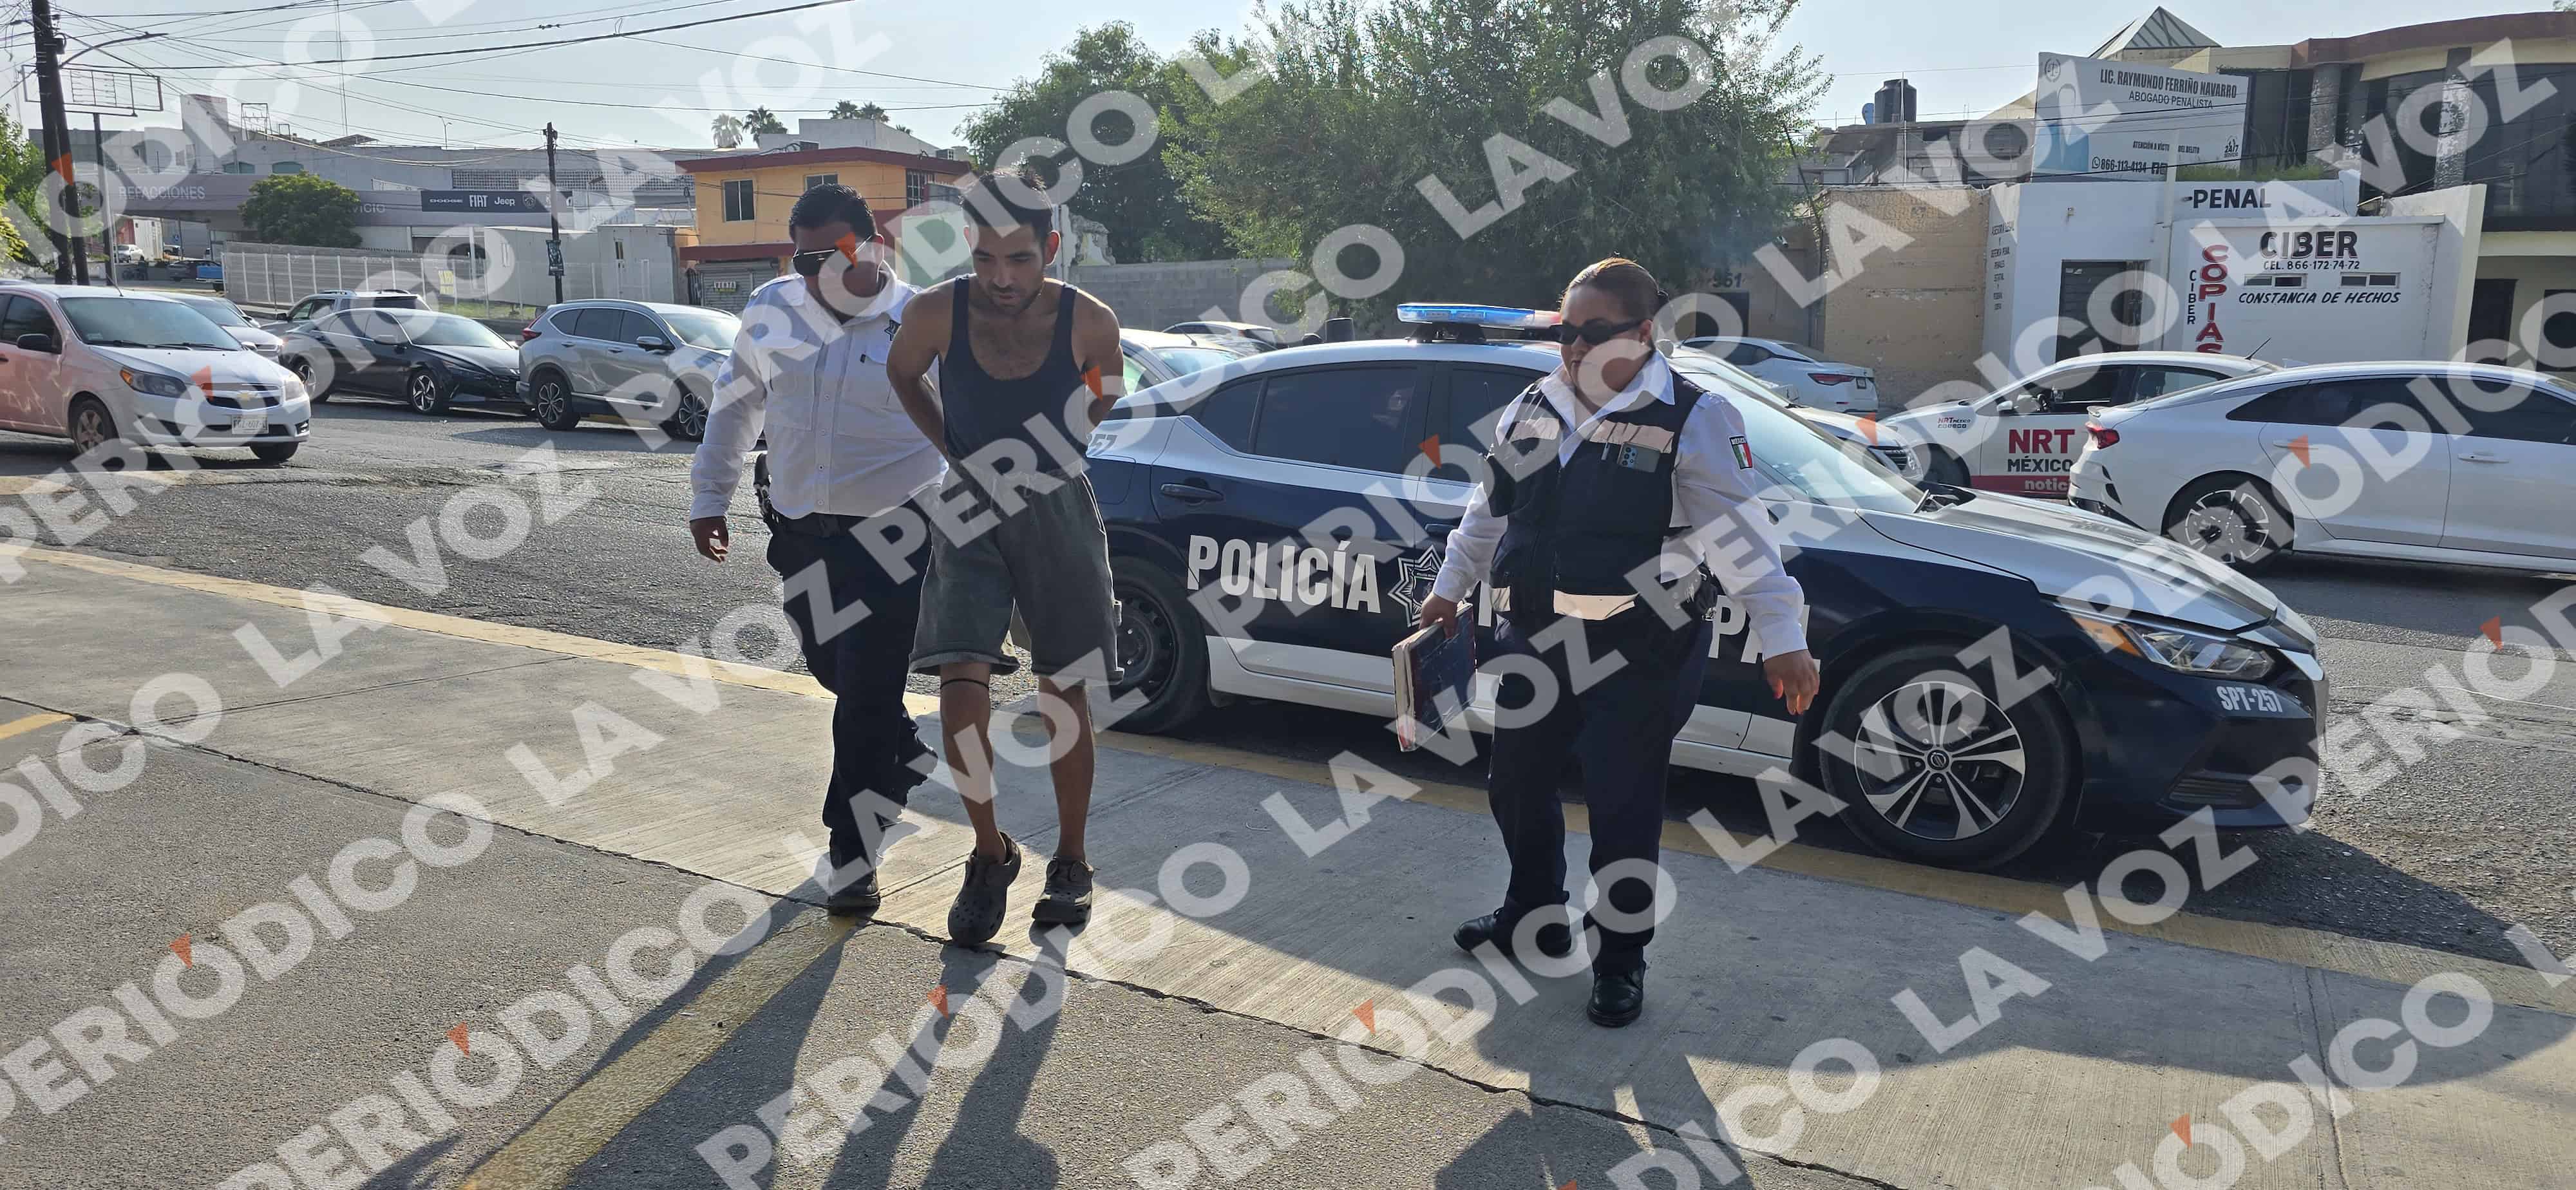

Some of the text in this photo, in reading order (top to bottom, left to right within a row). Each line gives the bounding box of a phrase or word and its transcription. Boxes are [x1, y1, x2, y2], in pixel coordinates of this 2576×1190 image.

[2100, 68, 2237, 99] LIC. RAYMUNDO FERRIÑO NAVARRO
[2128, 90, 2213, 109] ABOGADO PENALISTA
[2157, 142, 2170, 151] VÍCTI
[118, 185, 207, 200] REFACCIONES
[469, 194, 488, 207] FIAT
[494, 196, 516, 207] Jeep
[2193, 189, 2272, 208] PENAL
[2259, 231, 2358, 259] CIBER
[2263, 260, 2284, 270] CEL.
[2187, 270, 2197, 325] CIBER
[2239, 292, 2401, 304] CONSTANCIA DE HECHOS
[2009, 429, 2076, 454] NRT
[2007, 455, 2074, 472] MÉXICO
[2025, 478, 2070, 491] notic
[1186, 534, 1381, 614] POLICÍA
[2216, 686, 2283, 712] SPT-257
